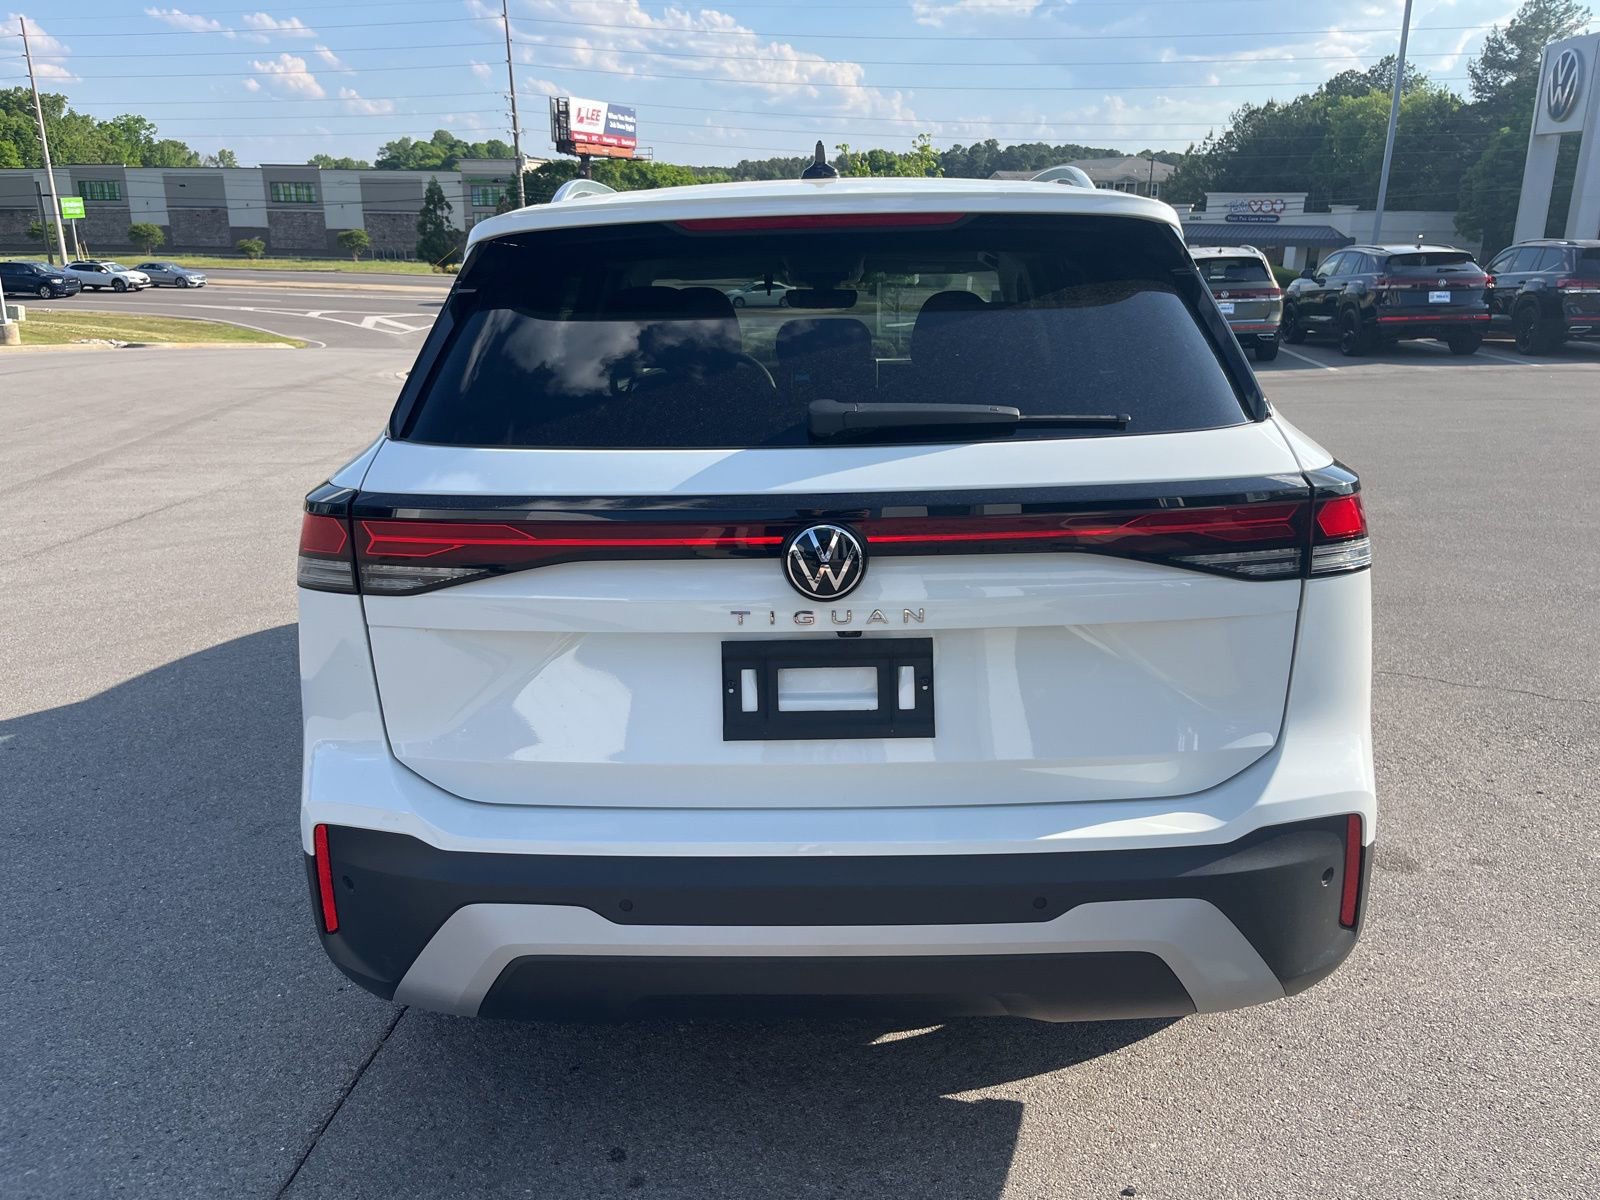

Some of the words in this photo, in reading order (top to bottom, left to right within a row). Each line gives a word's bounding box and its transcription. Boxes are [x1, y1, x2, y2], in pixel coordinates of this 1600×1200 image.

[586, 108, 602, 121] LEE
[788, 526, 862, 597] VW
[730, 607, 925, 626] TIGUAN
